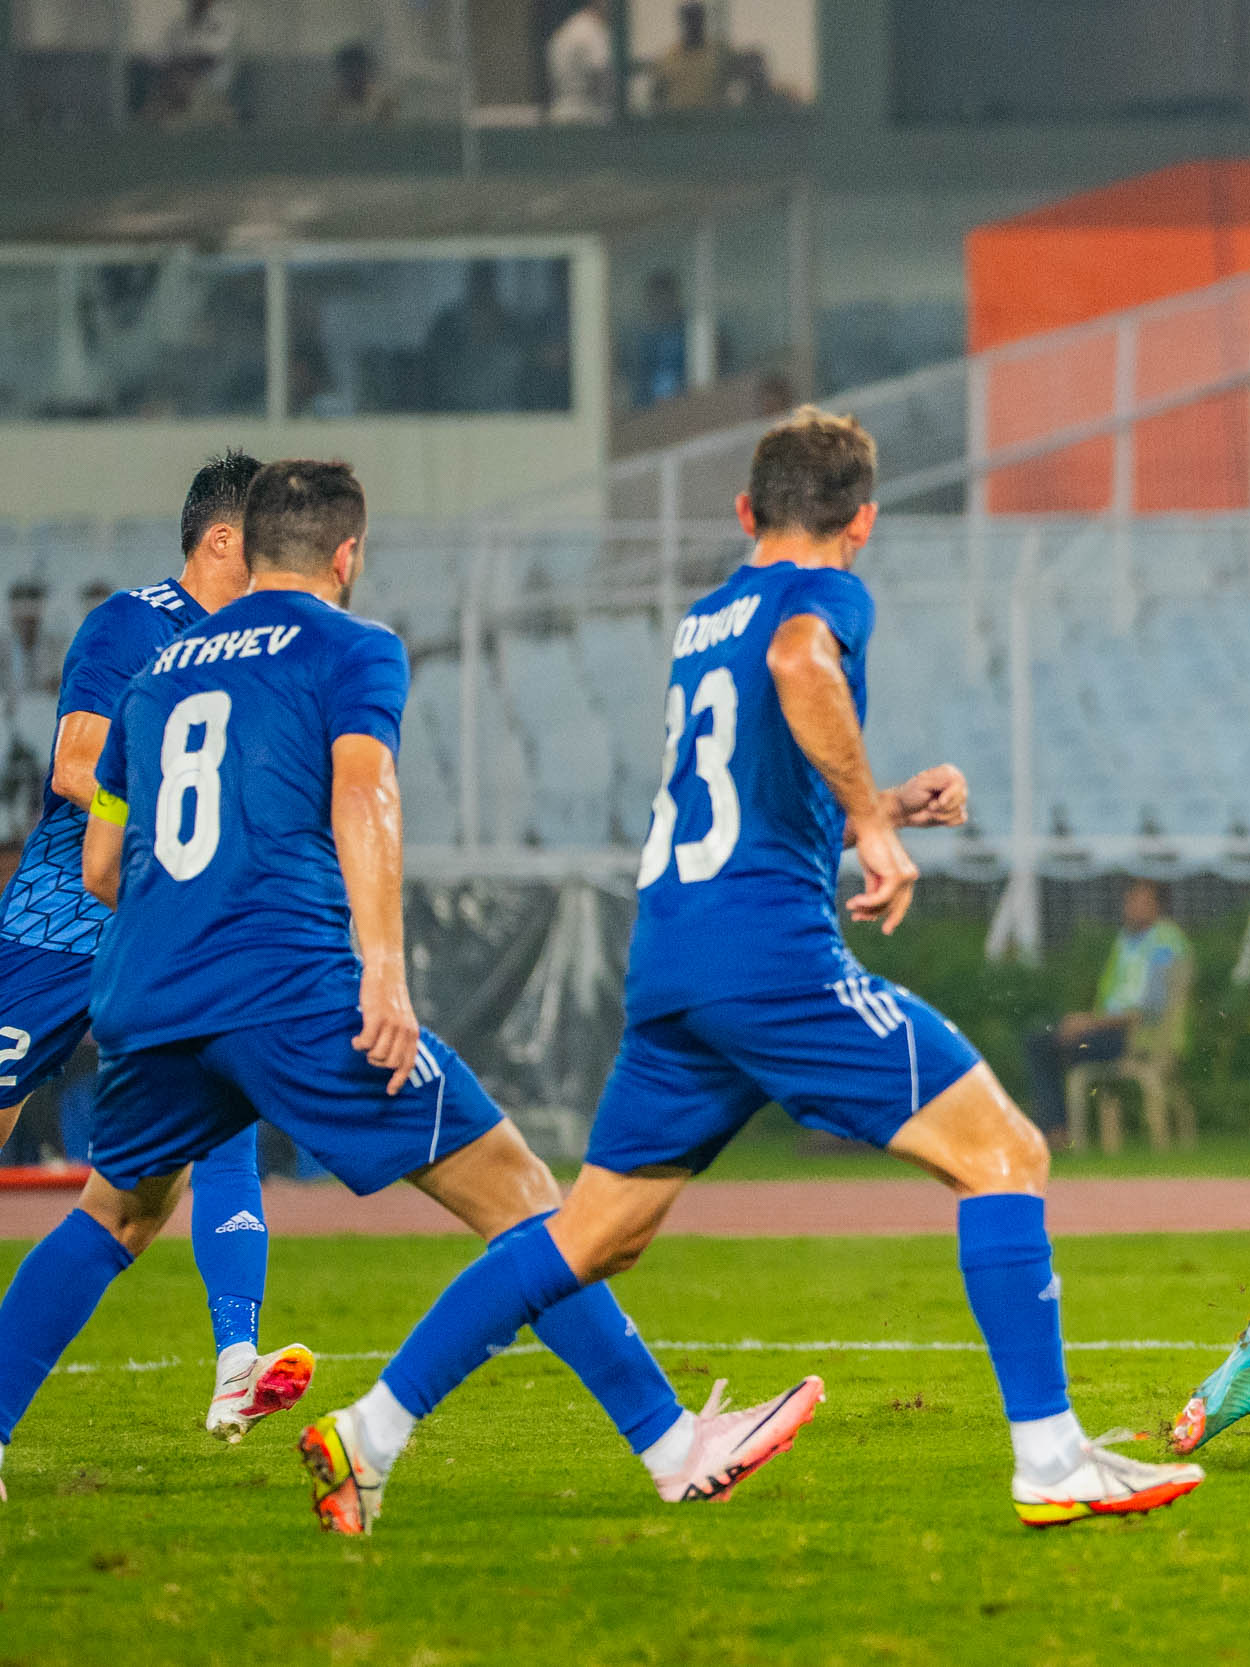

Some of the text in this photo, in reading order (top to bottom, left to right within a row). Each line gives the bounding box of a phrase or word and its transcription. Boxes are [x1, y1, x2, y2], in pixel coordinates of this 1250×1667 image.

[152, 625, 301, 675] ATAYEV
[154, 690, 232, 881] 8
[0, 1026, 30, 1086] 2
